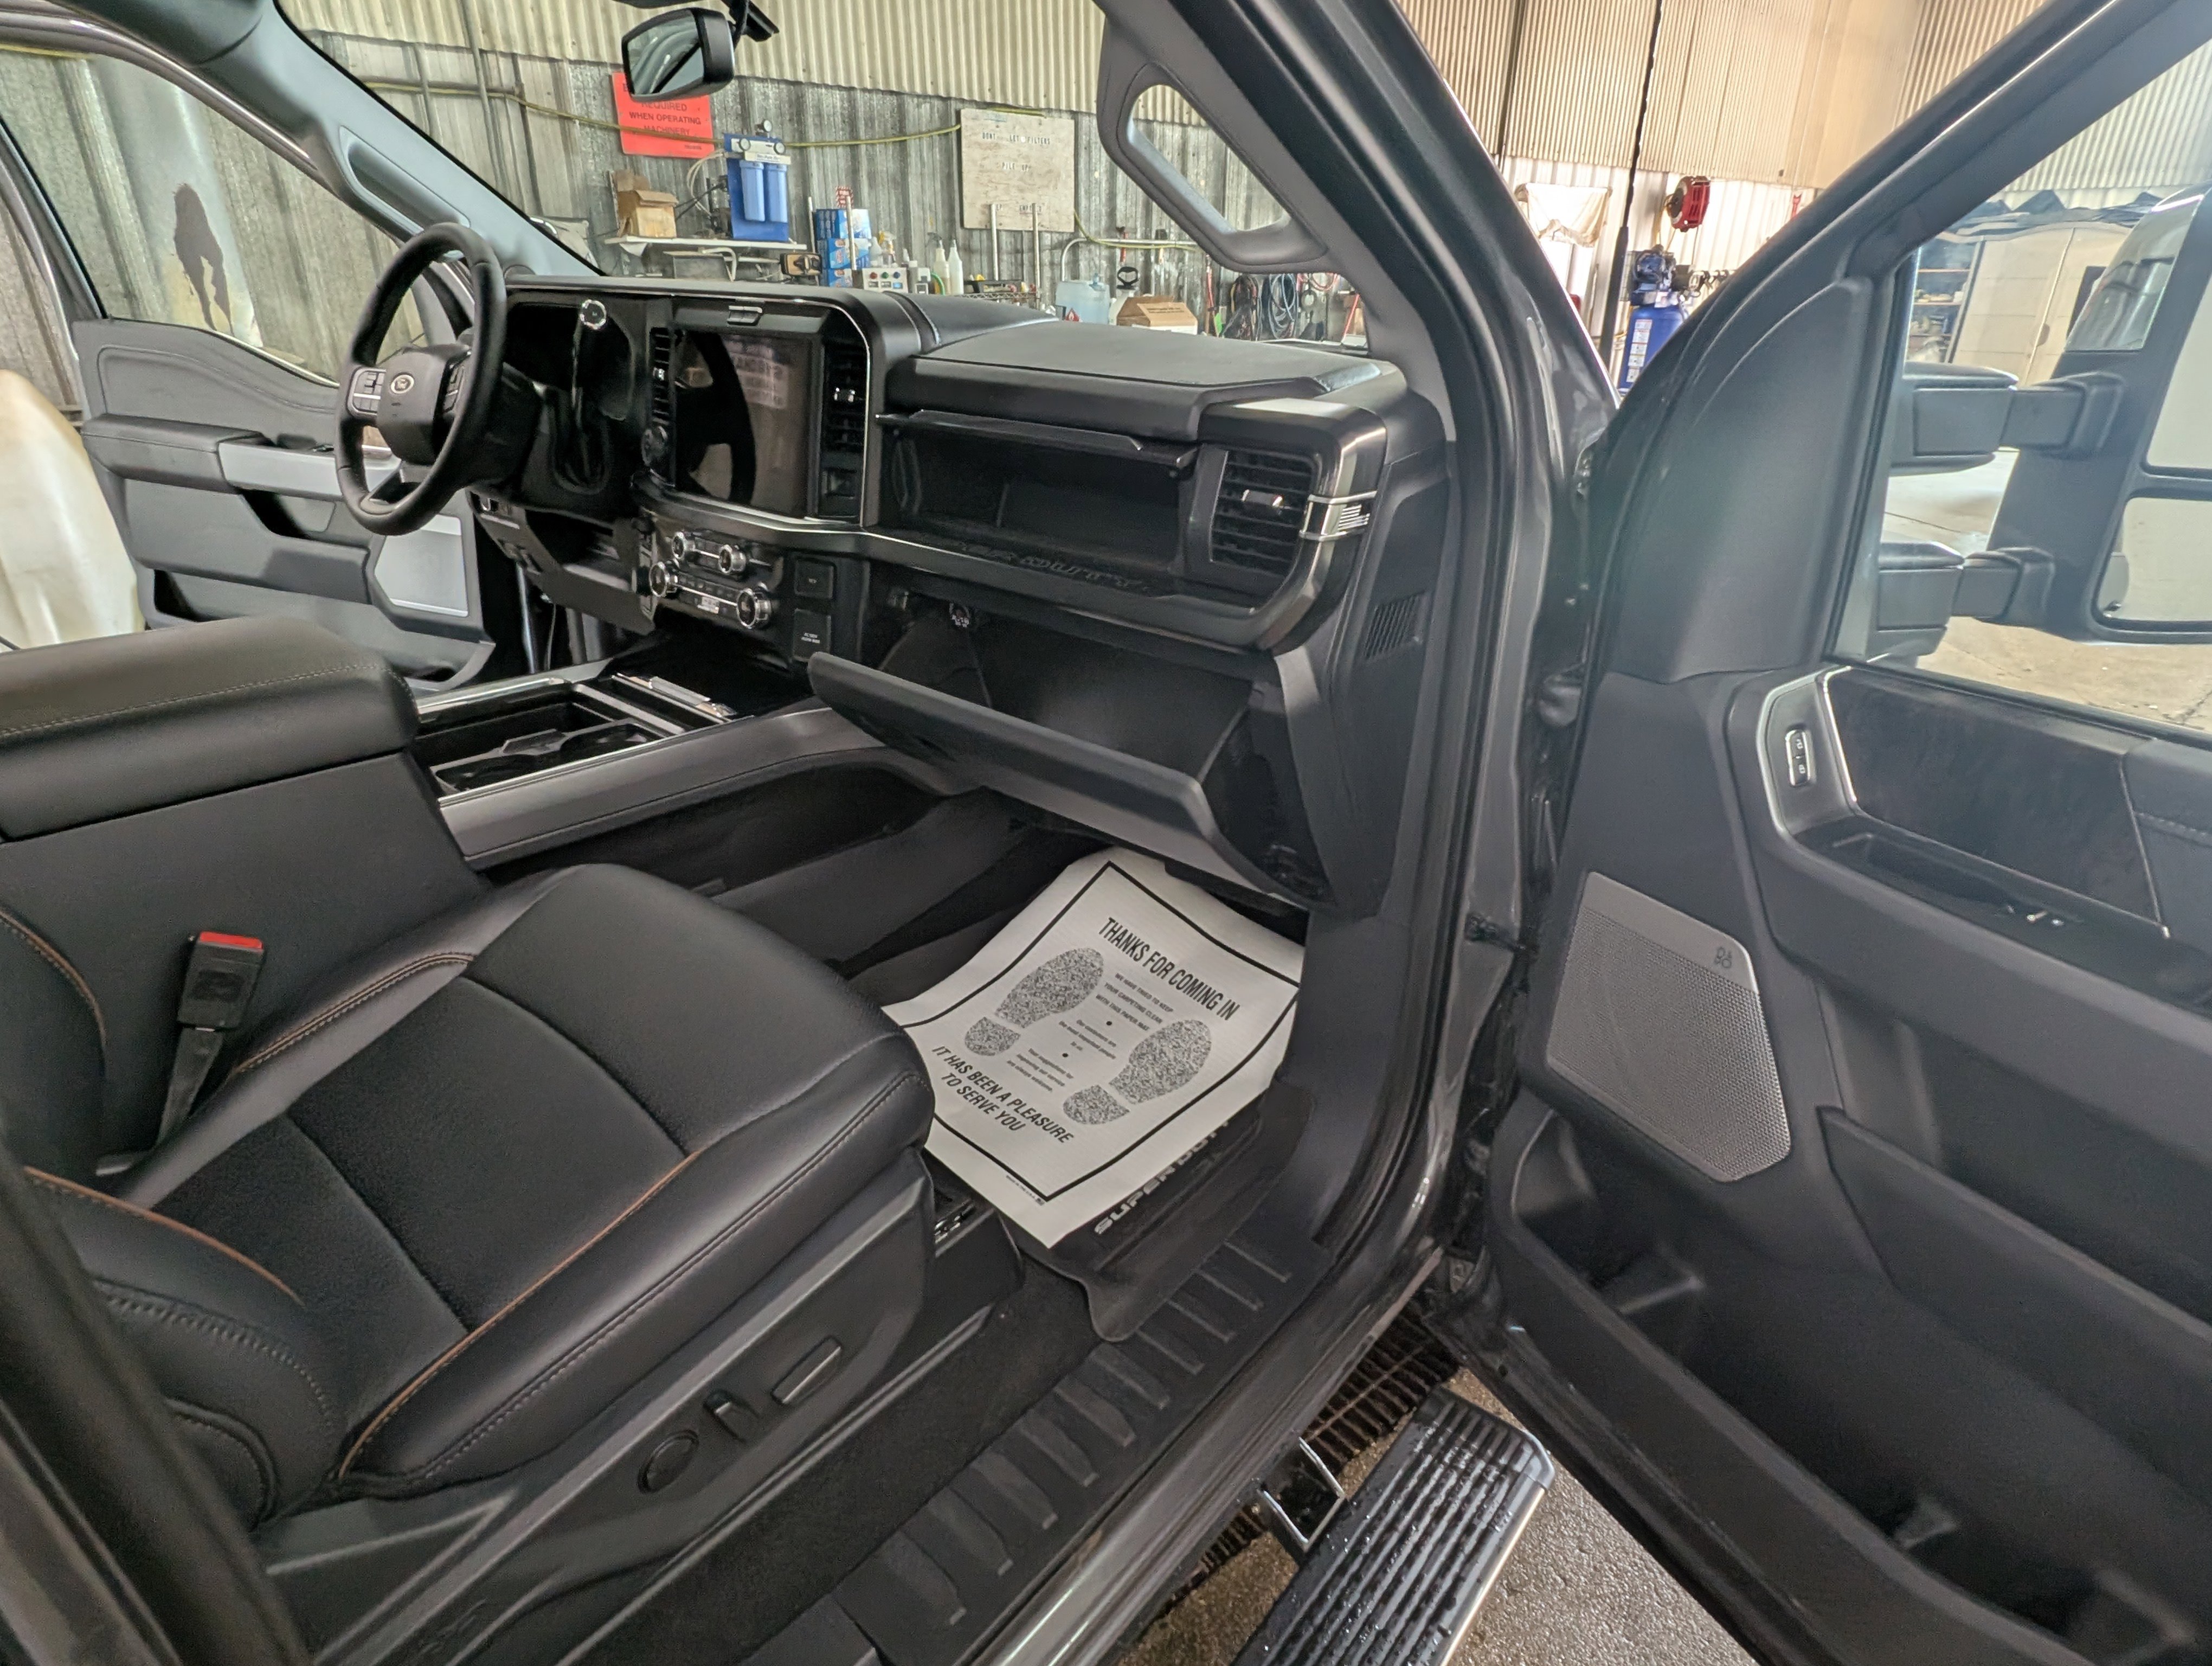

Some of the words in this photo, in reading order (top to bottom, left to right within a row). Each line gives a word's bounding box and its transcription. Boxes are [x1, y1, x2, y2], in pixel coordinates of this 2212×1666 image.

[629, 111, 654, 120] WHEN
[656, 114, 702, 125] OPERATING
[641, 101, 687, 112] REQUIRED
[644, 125, 690, 136] MACHINERY
[1098, 917, 1150, 962] THANKS
[1142, 951, 1175, 980] FOR
[1168, 969, 1224, 1011] COMING
[1216, 998, 1240, 1021] IN
[1123, 979, 1137, 990] HAVE
[1096, 994, 1110, 1005] WITH
[1121, 1011, 1139, 1024] PAPER
[1137, 1022, 1150, 1031] MAT
[1104, 982, 1119, 994] YOUR
[1118, 992, 1147, 1013] CARPETING
[1146, 1010, 1163, 1024] CLEAN
[931, 1046, 951, 1056] IT
[943, 1054, 973, 1074] HAS
[966, 1071, 1003, 1095] BEEN
[995, 1092, 1012, 1103] A
[1006, 1098, 1075, 1144] PLEASURE
[941, 1072, 962, 1087] TO
[956, 1085, 1000, 1115] SERVE
[994, 1110, 1026, 1131] YOU
